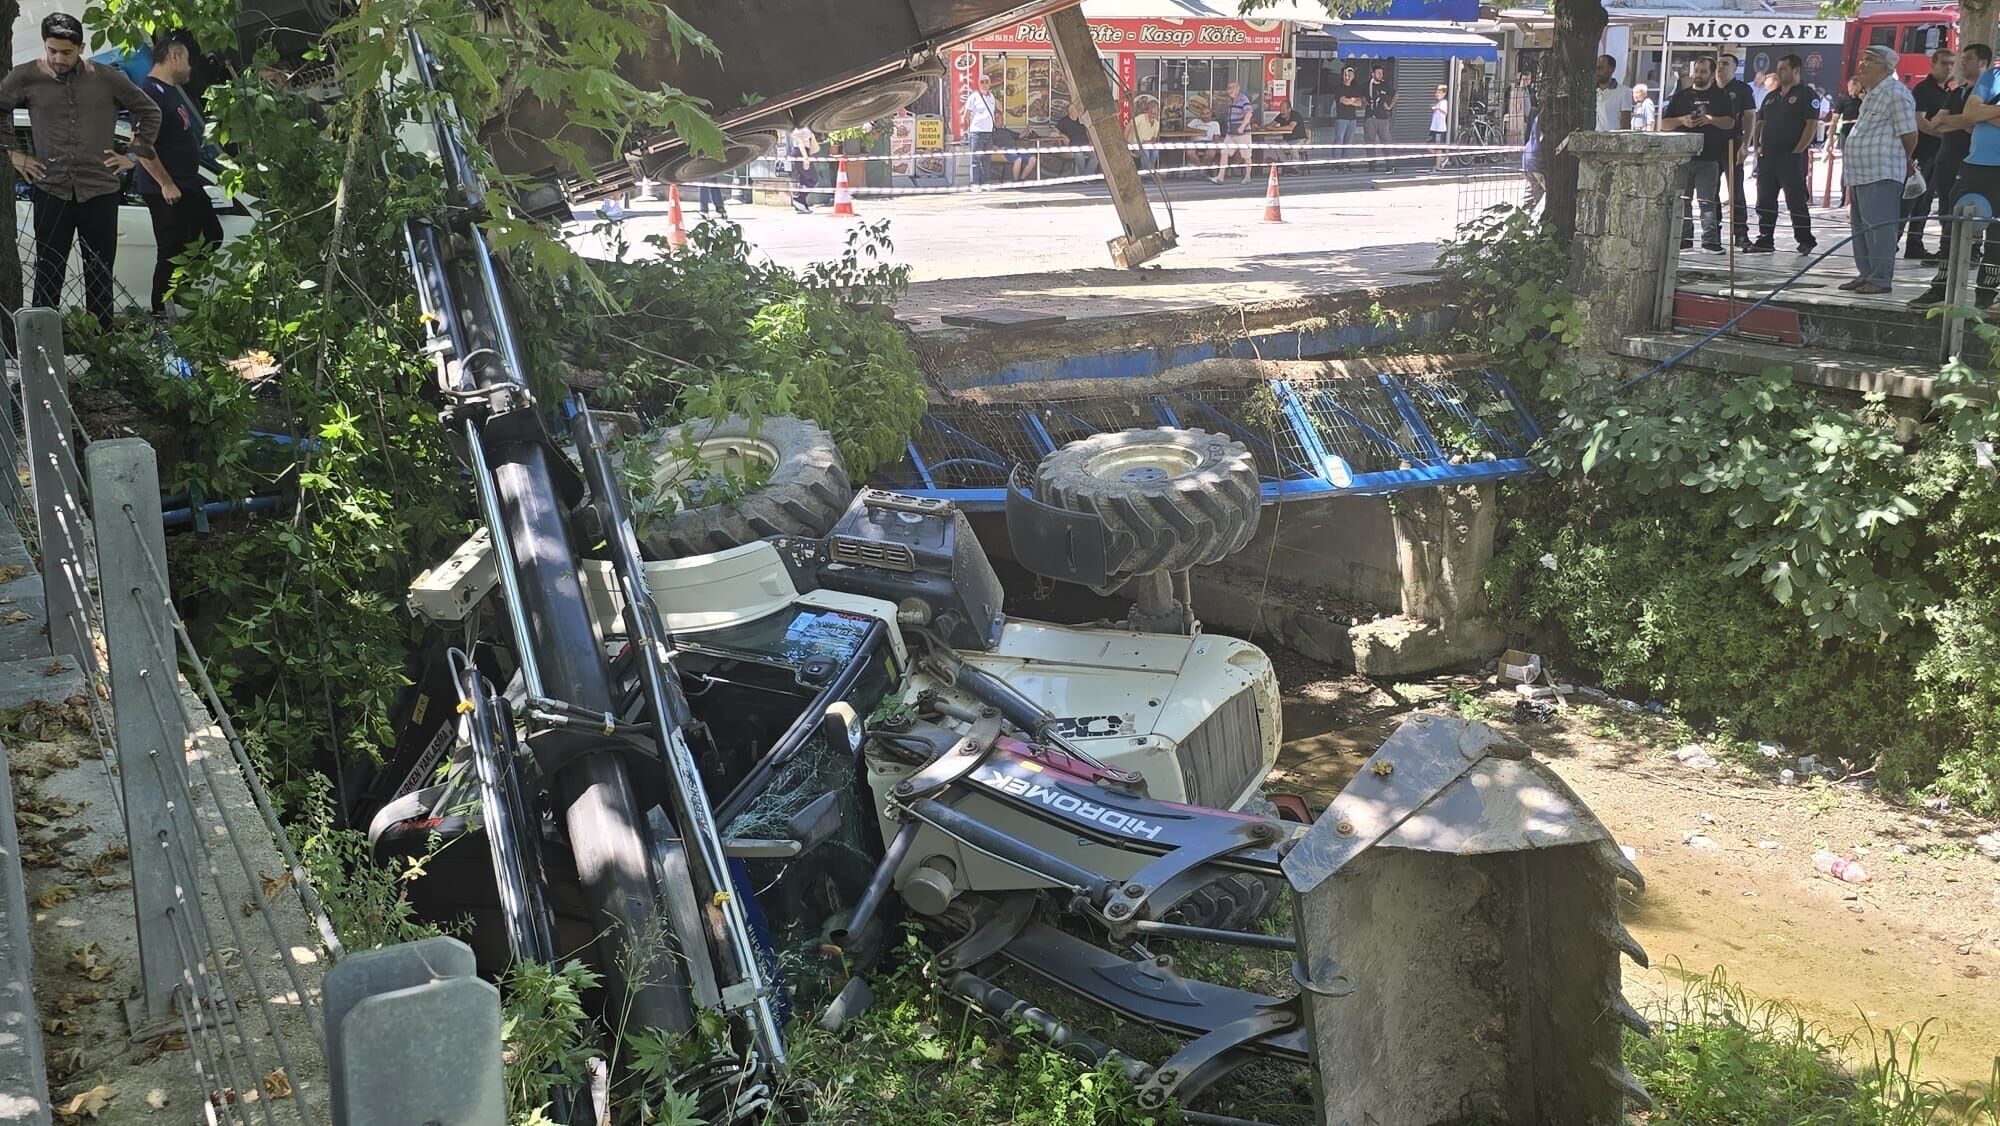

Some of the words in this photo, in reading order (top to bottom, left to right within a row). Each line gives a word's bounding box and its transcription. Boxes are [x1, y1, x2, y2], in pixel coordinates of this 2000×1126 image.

[1088, 23, 1123, 44] öfte
[1140, 24, 1194, 46] Kasap
[1198, 25, 1246, 43] Köfte
[1686, 19, 1750, 41] MİÇO
[1762, 24, 1828, 40] CAFE
